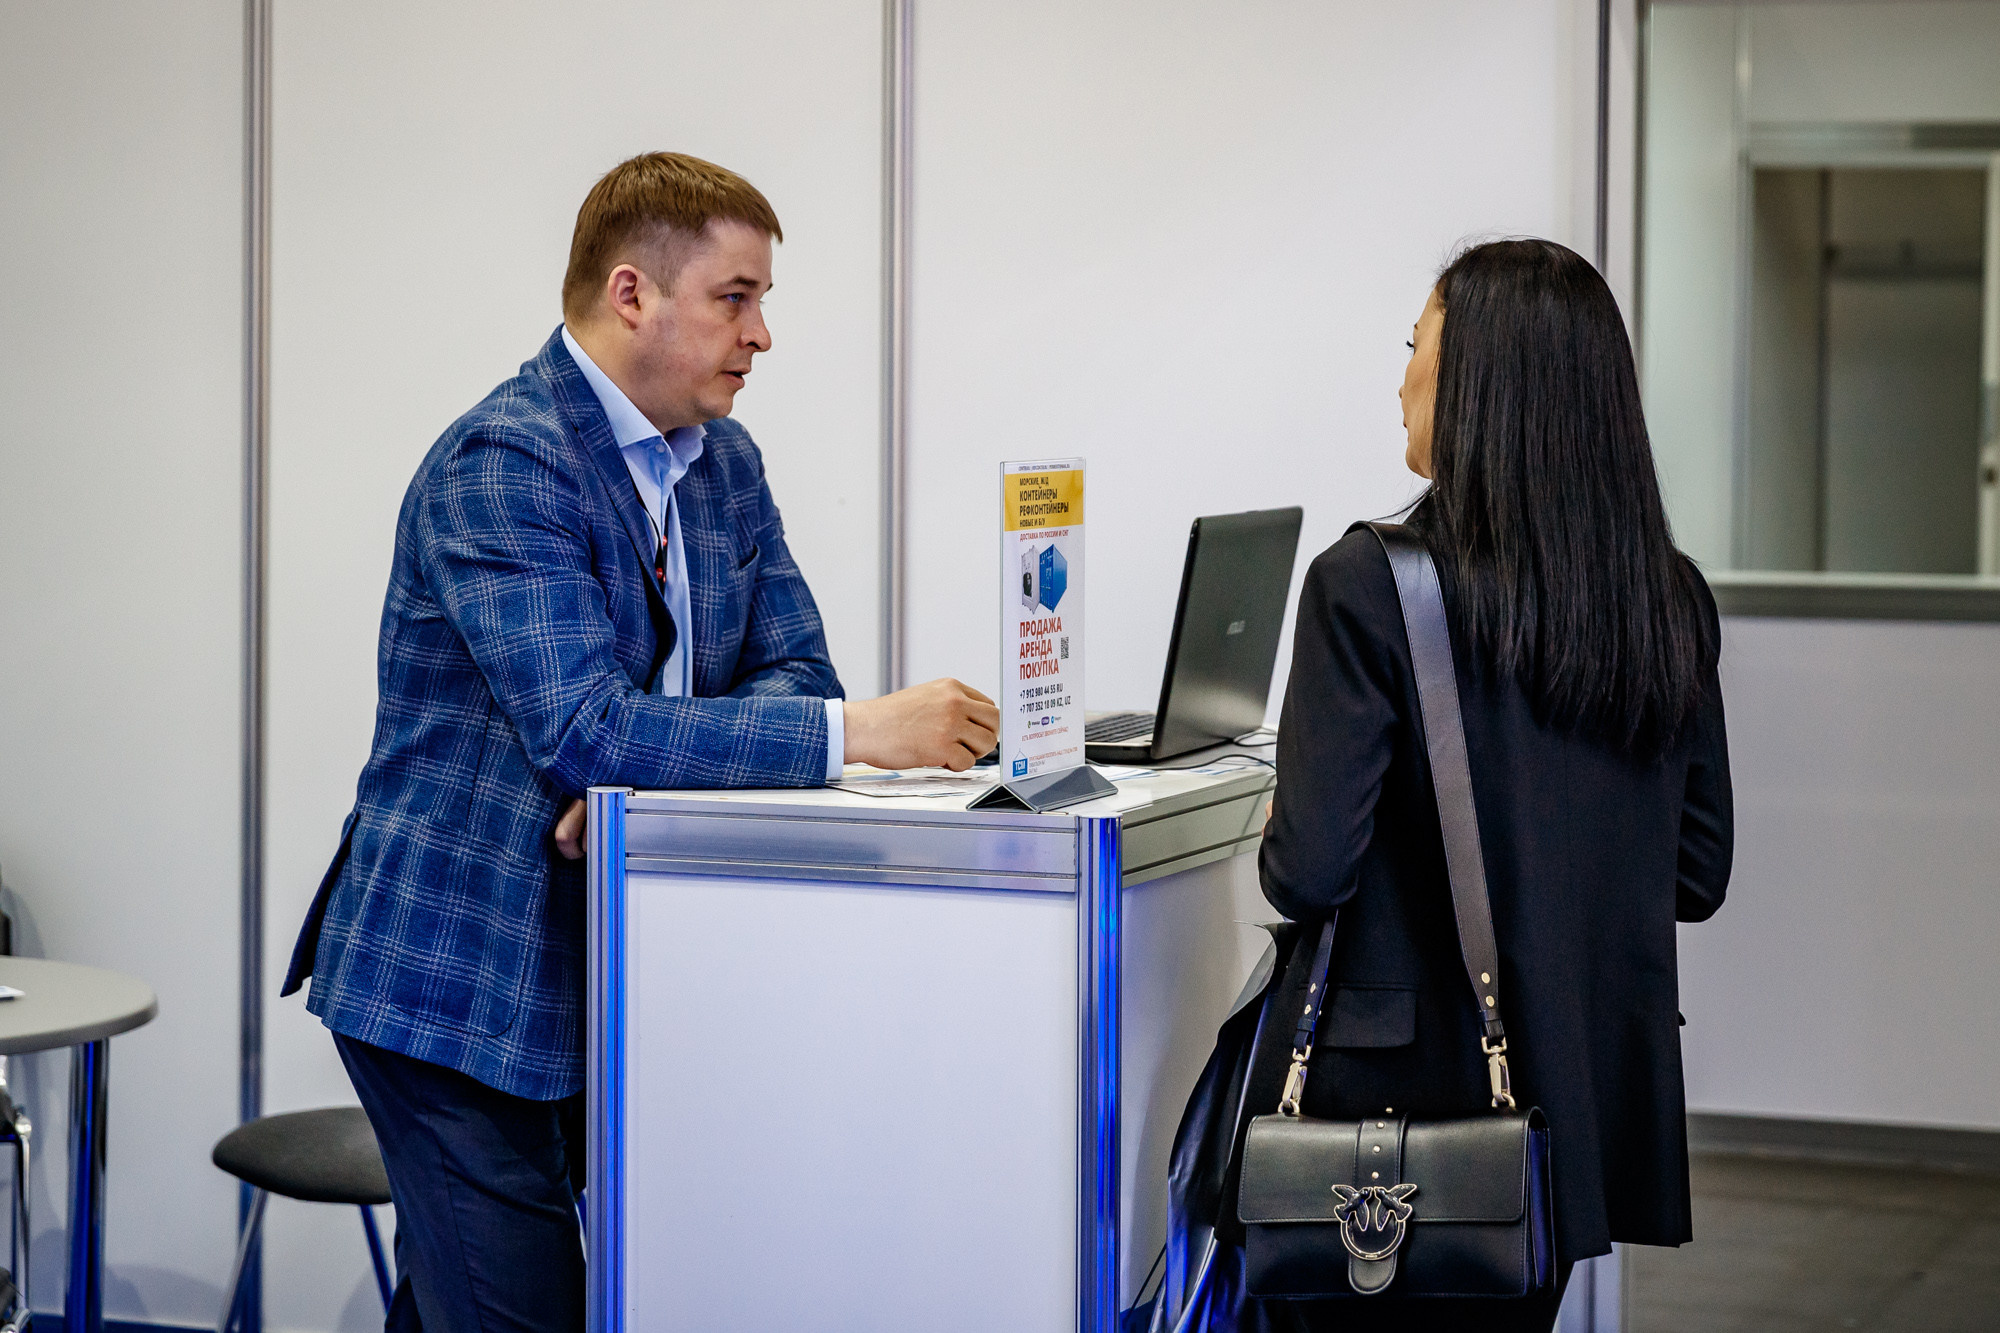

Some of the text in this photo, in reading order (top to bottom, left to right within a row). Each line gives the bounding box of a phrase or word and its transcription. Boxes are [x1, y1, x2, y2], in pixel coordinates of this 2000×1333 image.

[1020, 486, 1057, 501] КОНТЕЙНЕРЫ
[1020, 500, 1069, 516] РЕФКОНТЕЙНЕРЫ
[1020, 532, 1038, 542] ДОСТАВКА
[1020, 617, 1062, 640] ПРОДАЖА
[1020, 639, 1052, 660] АРЕНДА
[1020, 658, 1059, 680] ПОКУПКА
[1020, 689, 1025, 699] +7
[1026, 688, 1034, 698] 912
[1056, 683, 1063, 693] RU
[1020, 705, 1026, 714] +7
